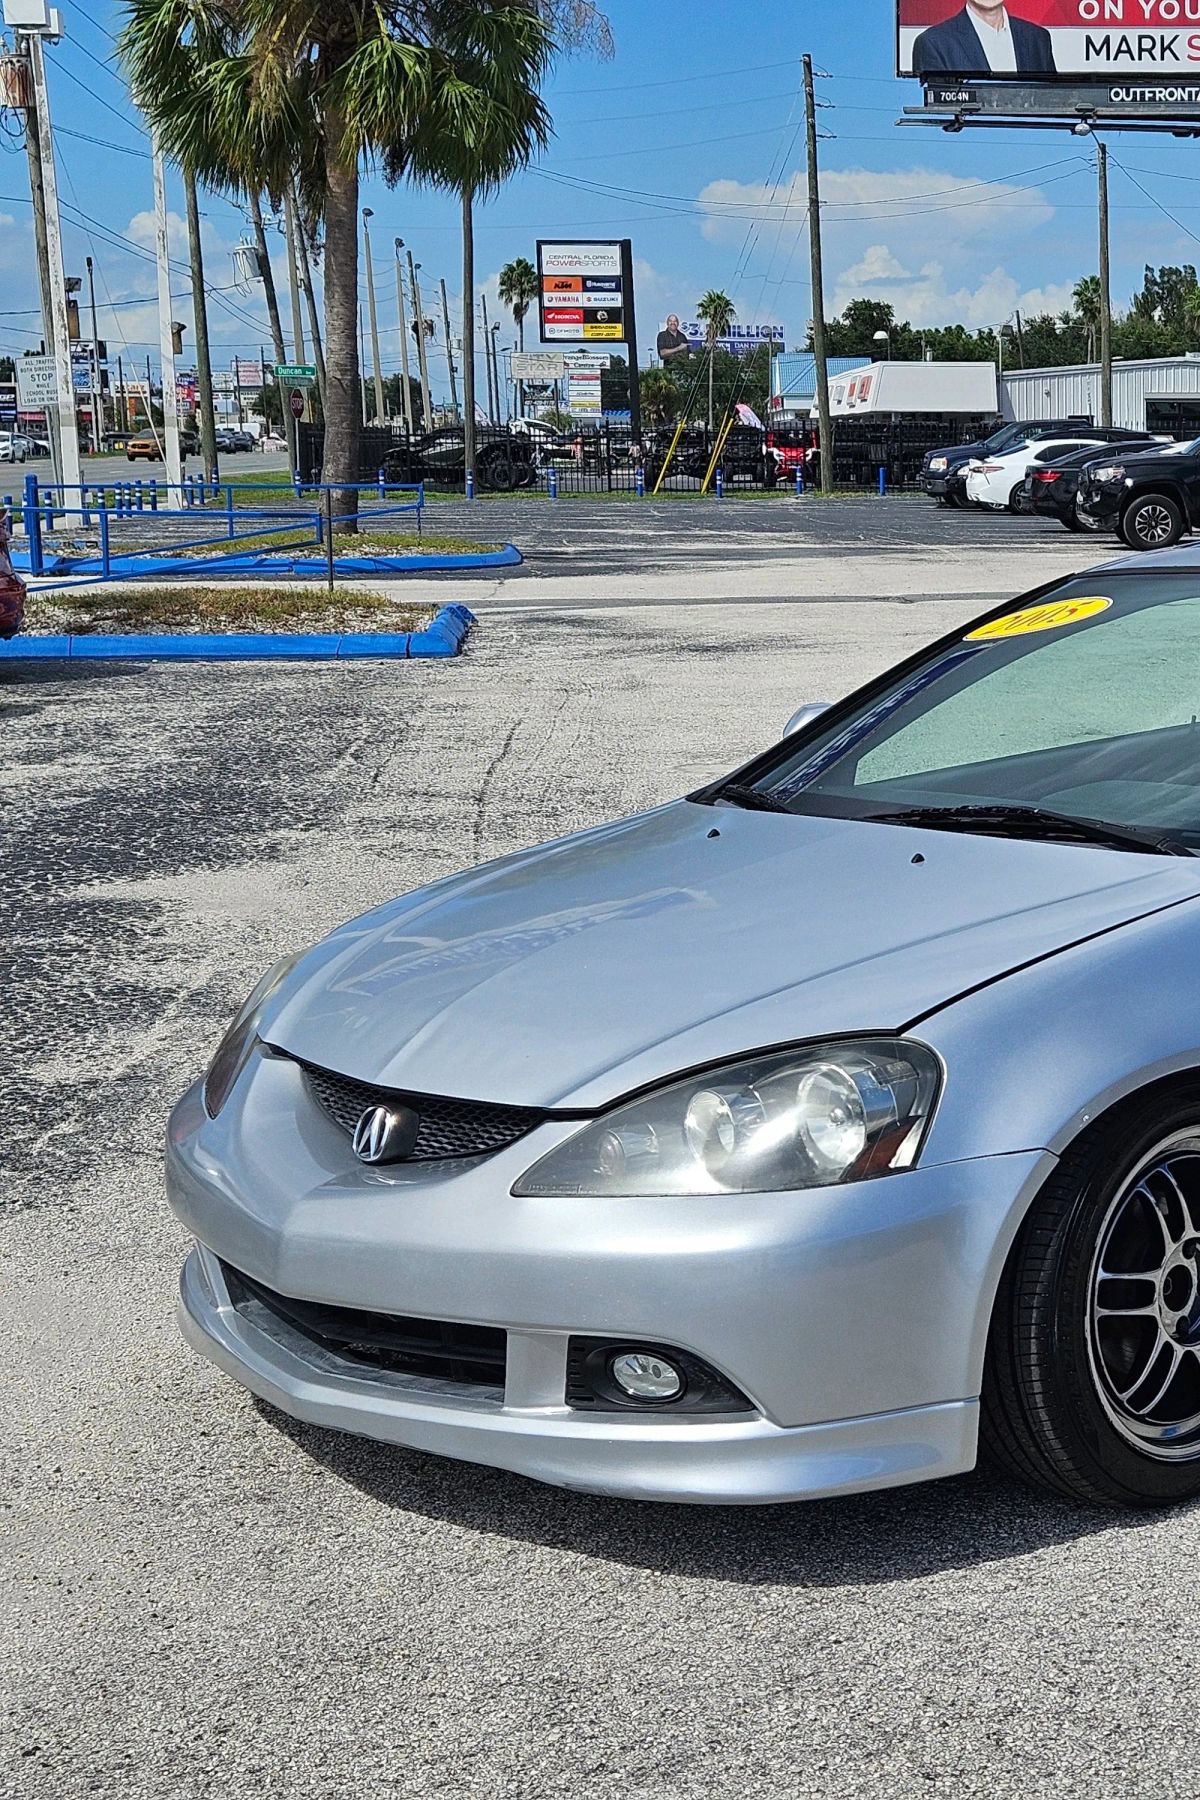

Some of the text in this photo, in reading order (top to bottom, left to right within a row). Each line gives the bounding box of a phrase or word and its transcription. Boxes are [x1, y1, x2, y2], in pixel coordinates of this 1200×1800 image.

[1078, 0, 1124, 20] ON
[1085, 34, 1180, 62] MARK
[554, 281, 573, 289] KTM
[554, 295, 580, 303] YAMAHA
[278, 367, 303, 375] Duncan
[30, 373, 53, 382] STOP
[291, 397, 304, 410] STOP
